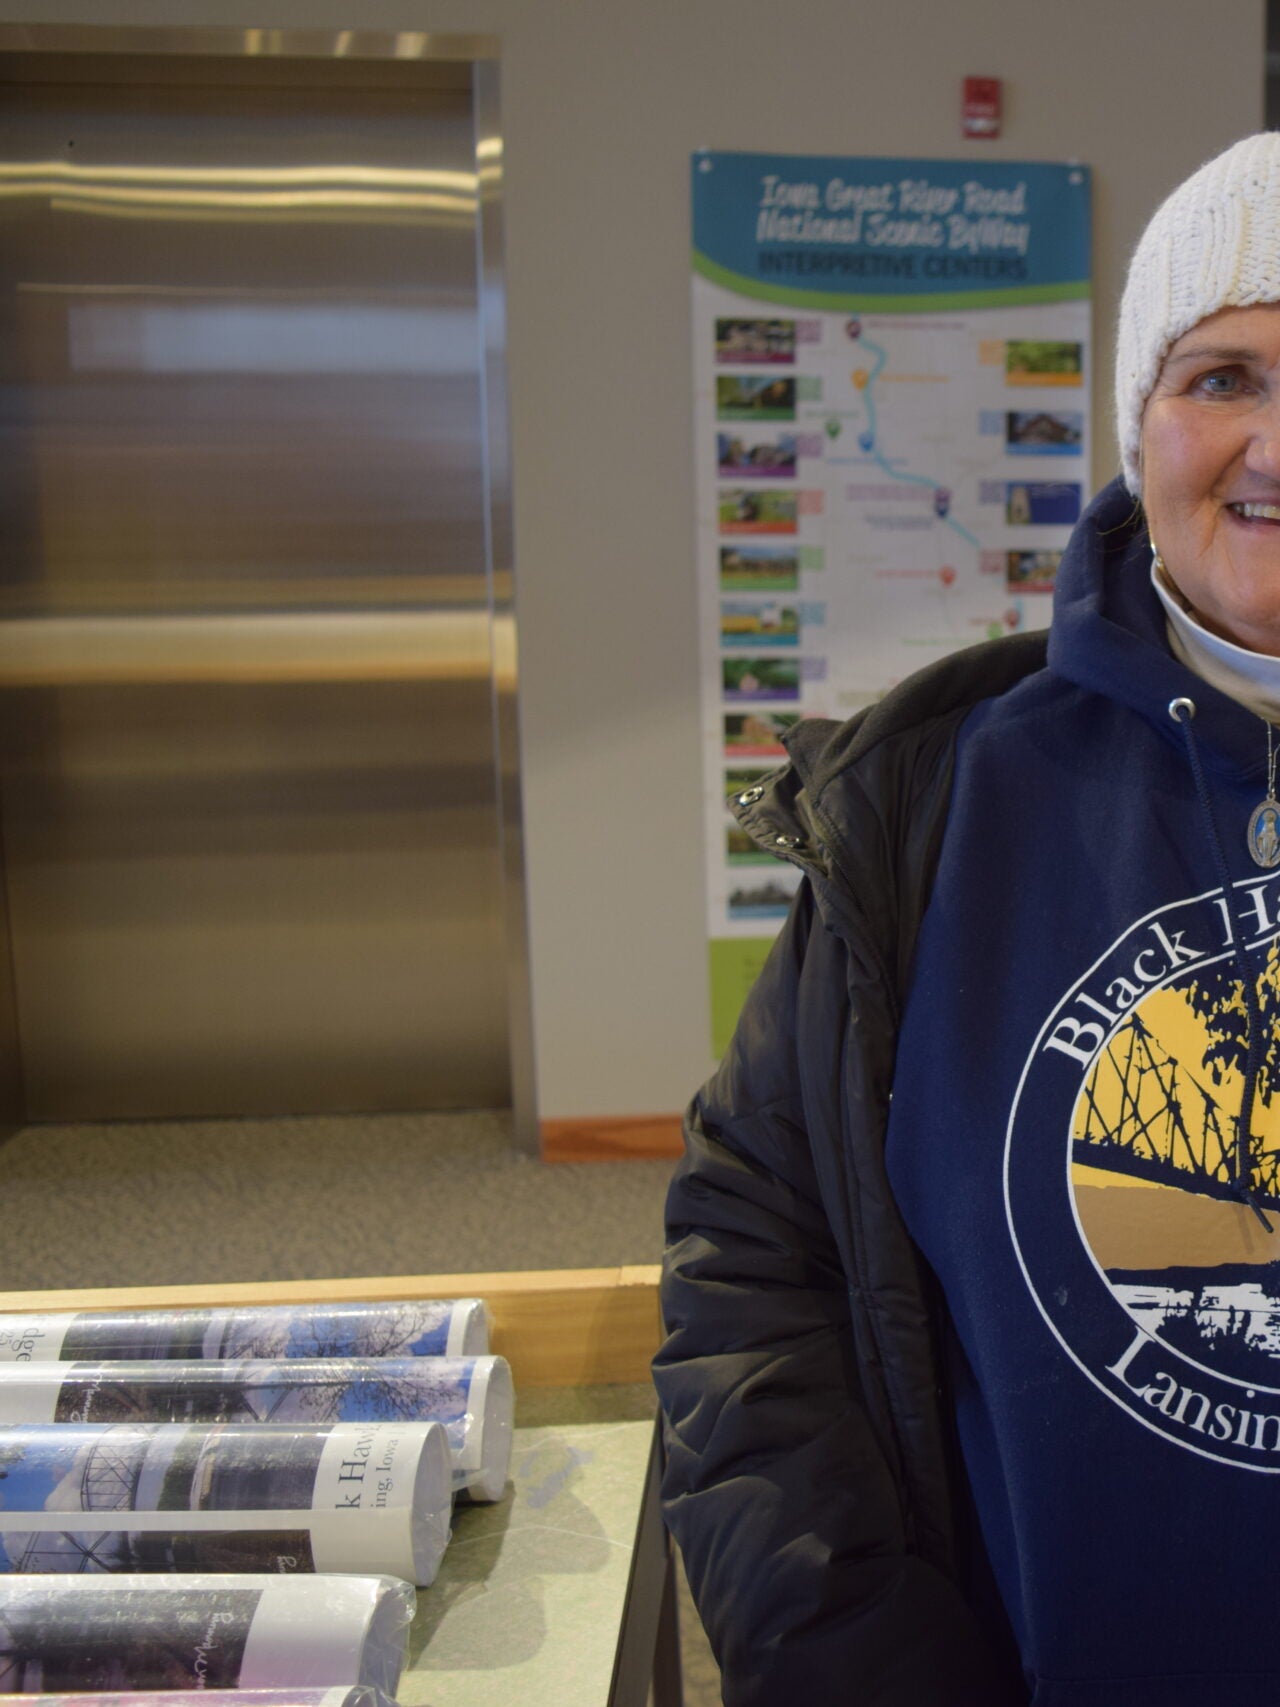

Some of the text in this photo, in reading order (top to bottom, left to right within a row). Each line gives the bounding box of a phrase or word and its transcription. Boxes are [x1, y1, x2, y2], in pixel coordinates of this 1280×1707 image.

[760, 175, 1028, 215] Iowa Great River Road
[756, 207, 863, 243] National
[865, 212, 946, 248] Scenic
[757, 251, 1028, 280] INTERPRETIVE CENTERS
[1042, 921, 1206, 1071] Black
